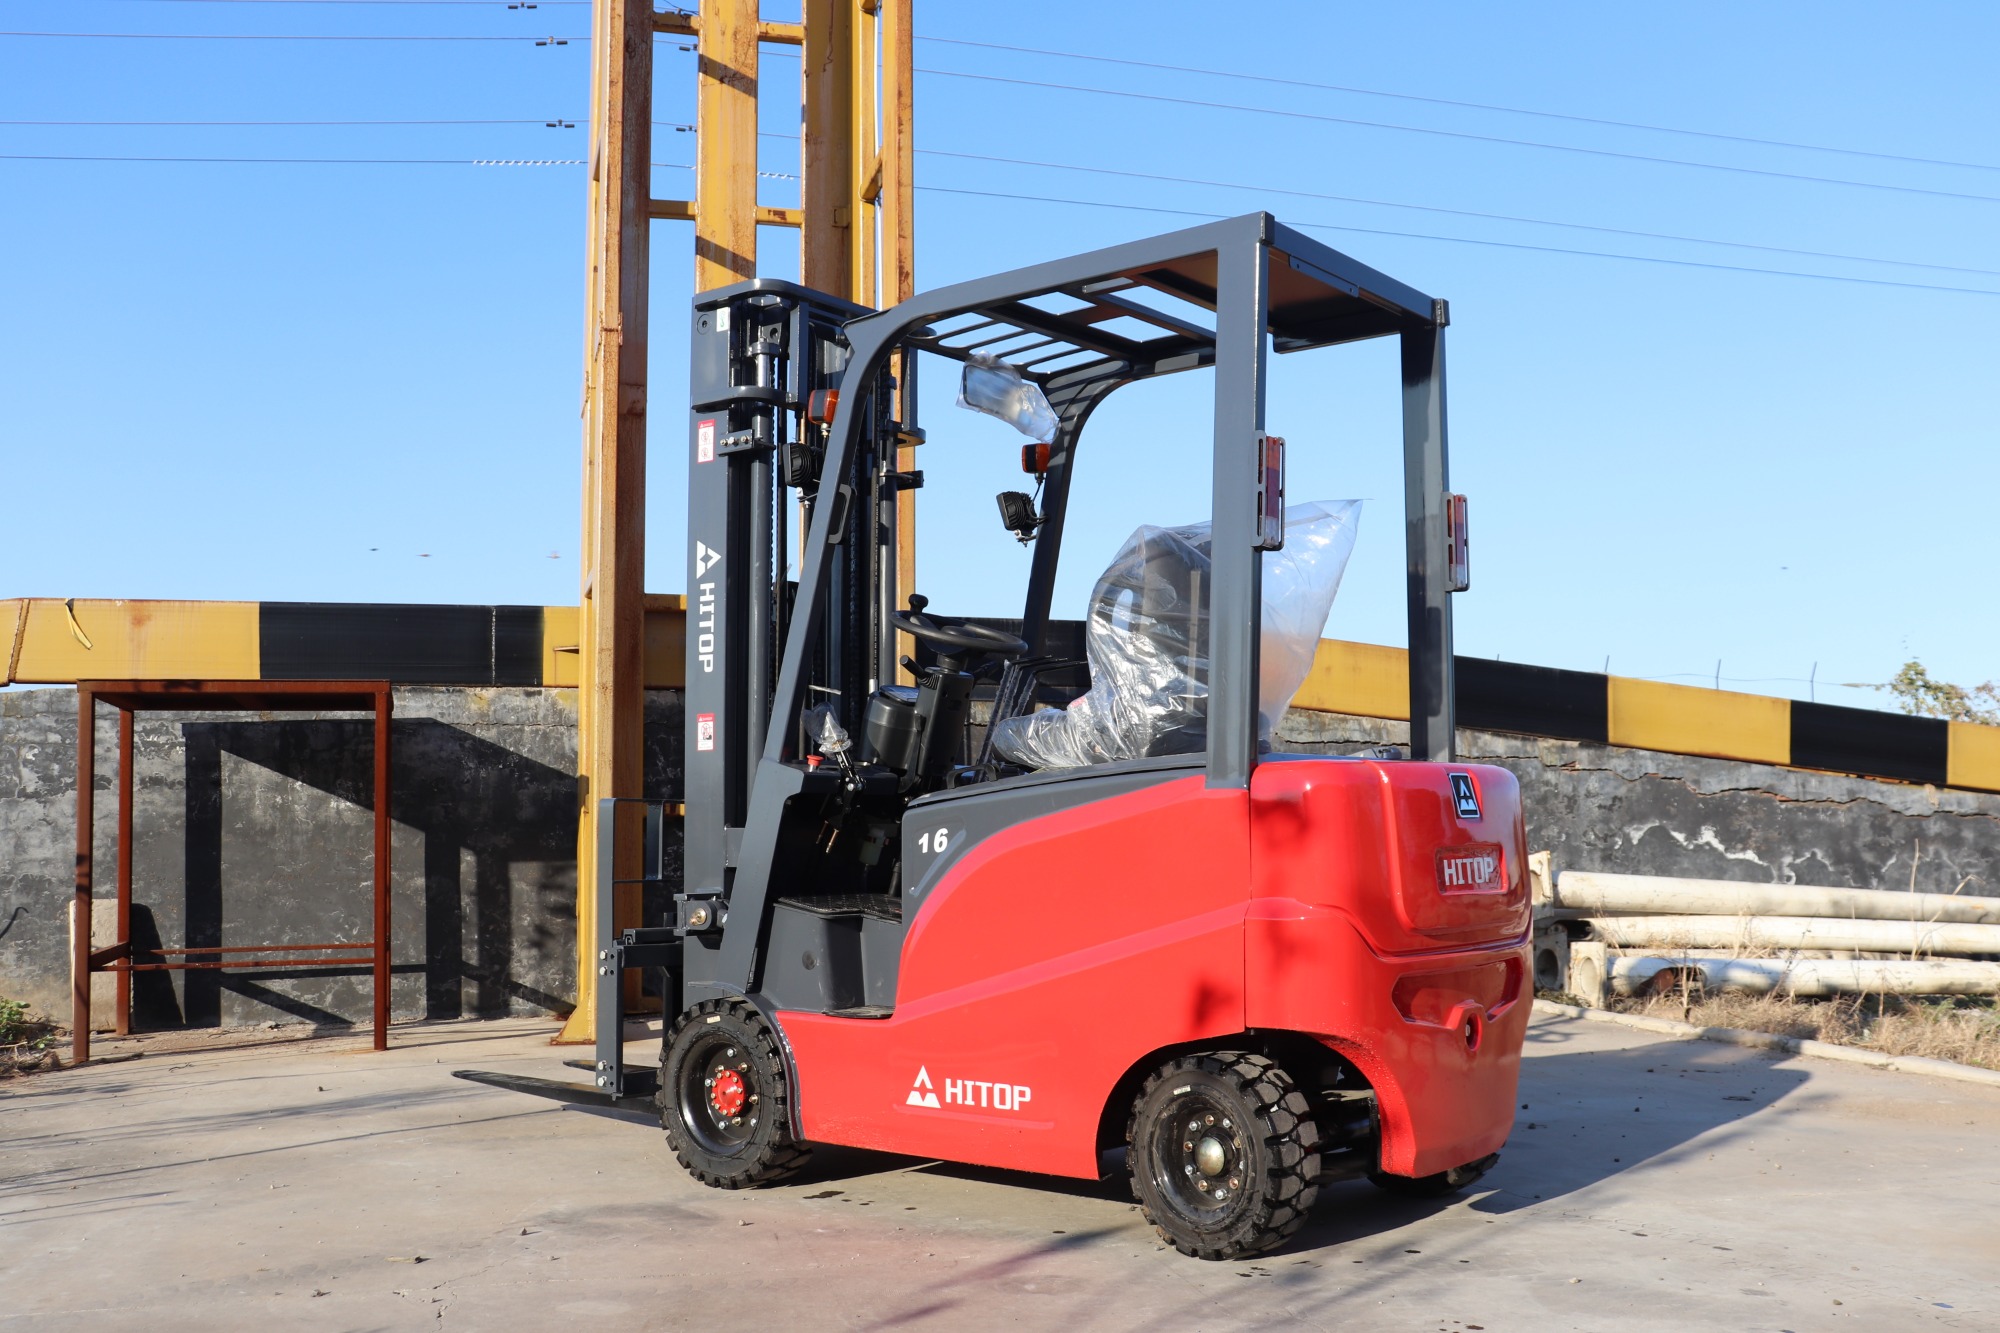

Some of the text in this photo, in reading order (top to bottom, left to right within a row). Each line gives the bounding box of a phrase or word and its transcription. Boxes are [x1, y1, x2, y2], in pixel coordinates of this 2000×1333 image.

[698, 582, 715, 673] HITOP
[918, 827, 949, 854] 16
[1443, 856, 1494, 886] HITOP
[945, 1077, 1031, 1111] HITOP
